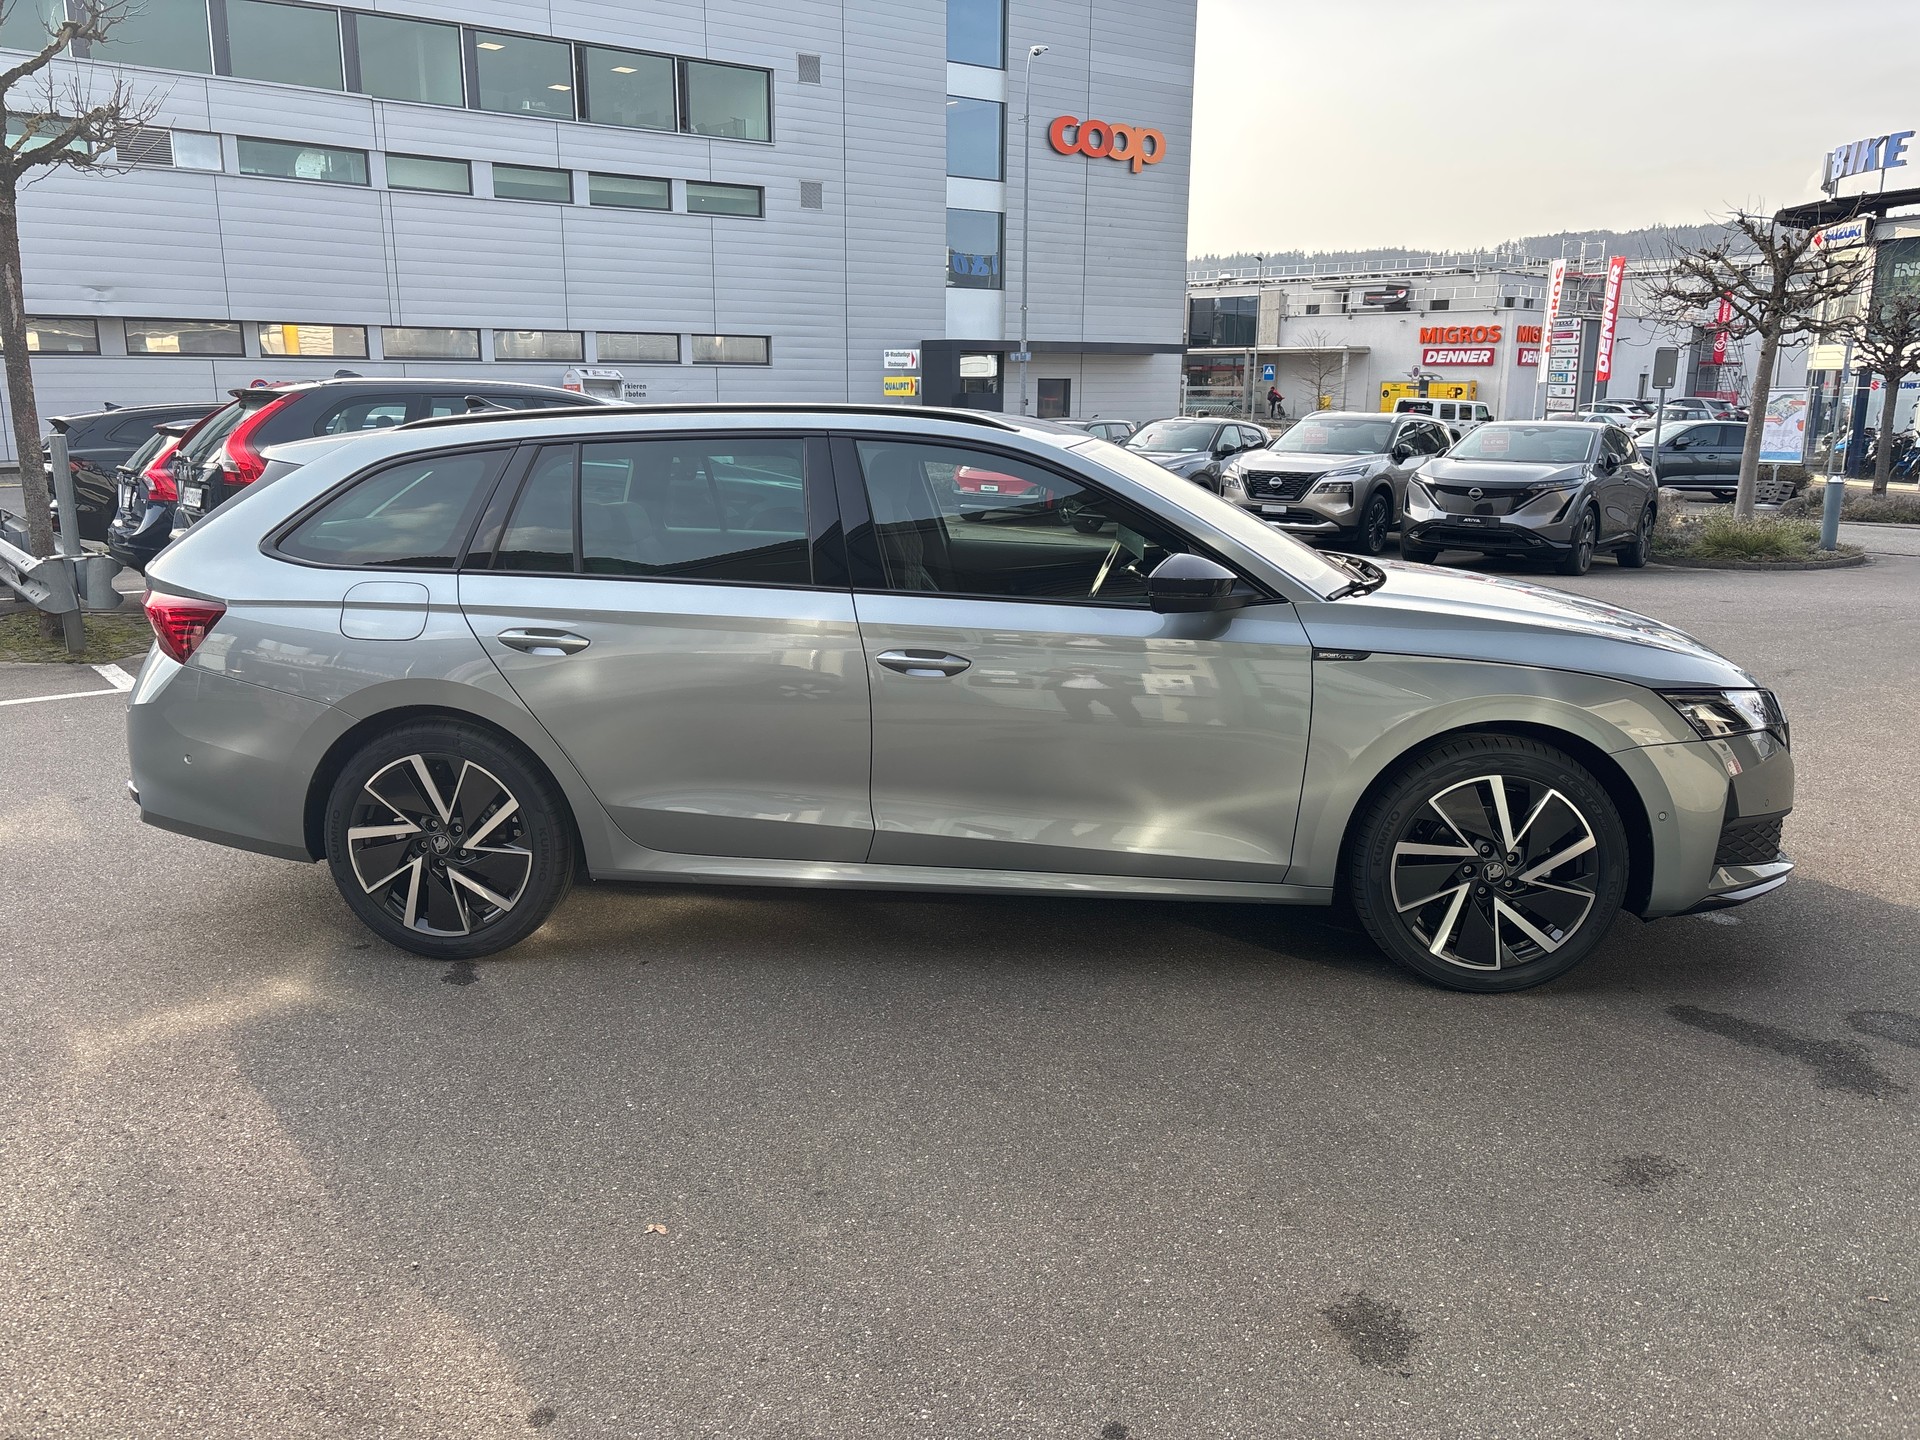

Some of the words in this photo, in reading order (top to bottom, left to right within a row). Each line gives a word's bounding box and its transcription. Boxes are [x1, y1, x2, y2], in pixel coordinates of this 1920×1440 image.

[1048, 115, 1167, 173] coop
[1831, 131, 1916, 182] BIKE
[1419, 325, 1502, 345] MIGROS
[1598, 264, 1621, 373] DENNER
[1425, 350, 1491, 363] DENNER
[884, 382, 910, 391] QUALIPET
